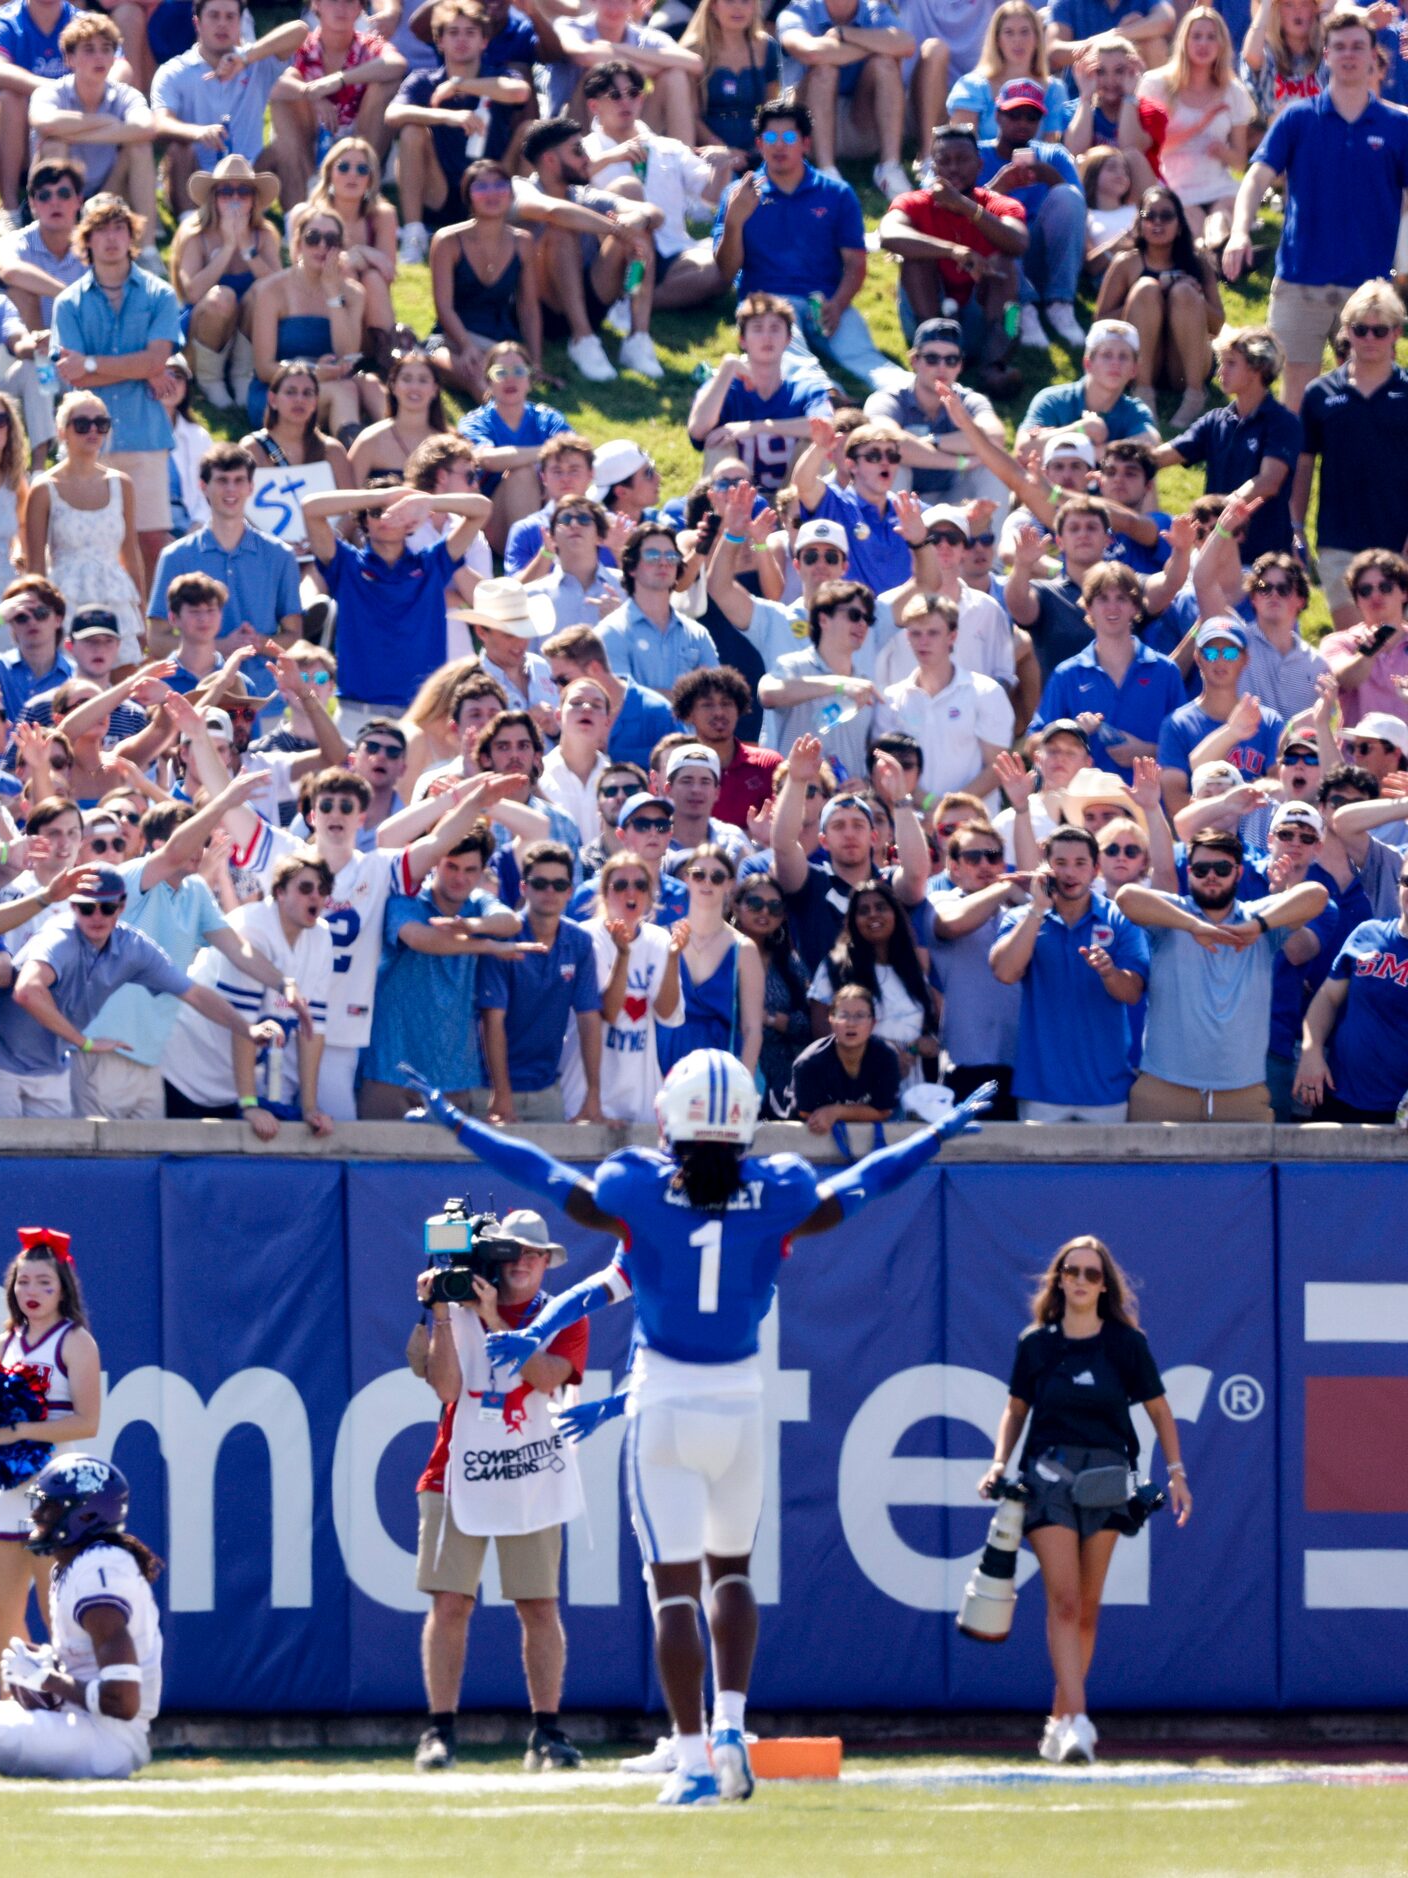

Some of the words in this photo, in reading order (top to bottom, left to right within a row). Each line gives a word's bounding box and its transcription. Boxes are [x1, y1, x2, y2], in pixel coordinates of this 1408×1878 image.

[690, 1220, 724, 1314] 1
[464, 1433, 565, 1467] COMPETITIVE
[464, 1452, 539, 1482] CAMERAS
[98, 1567, 106, 1588] 1
